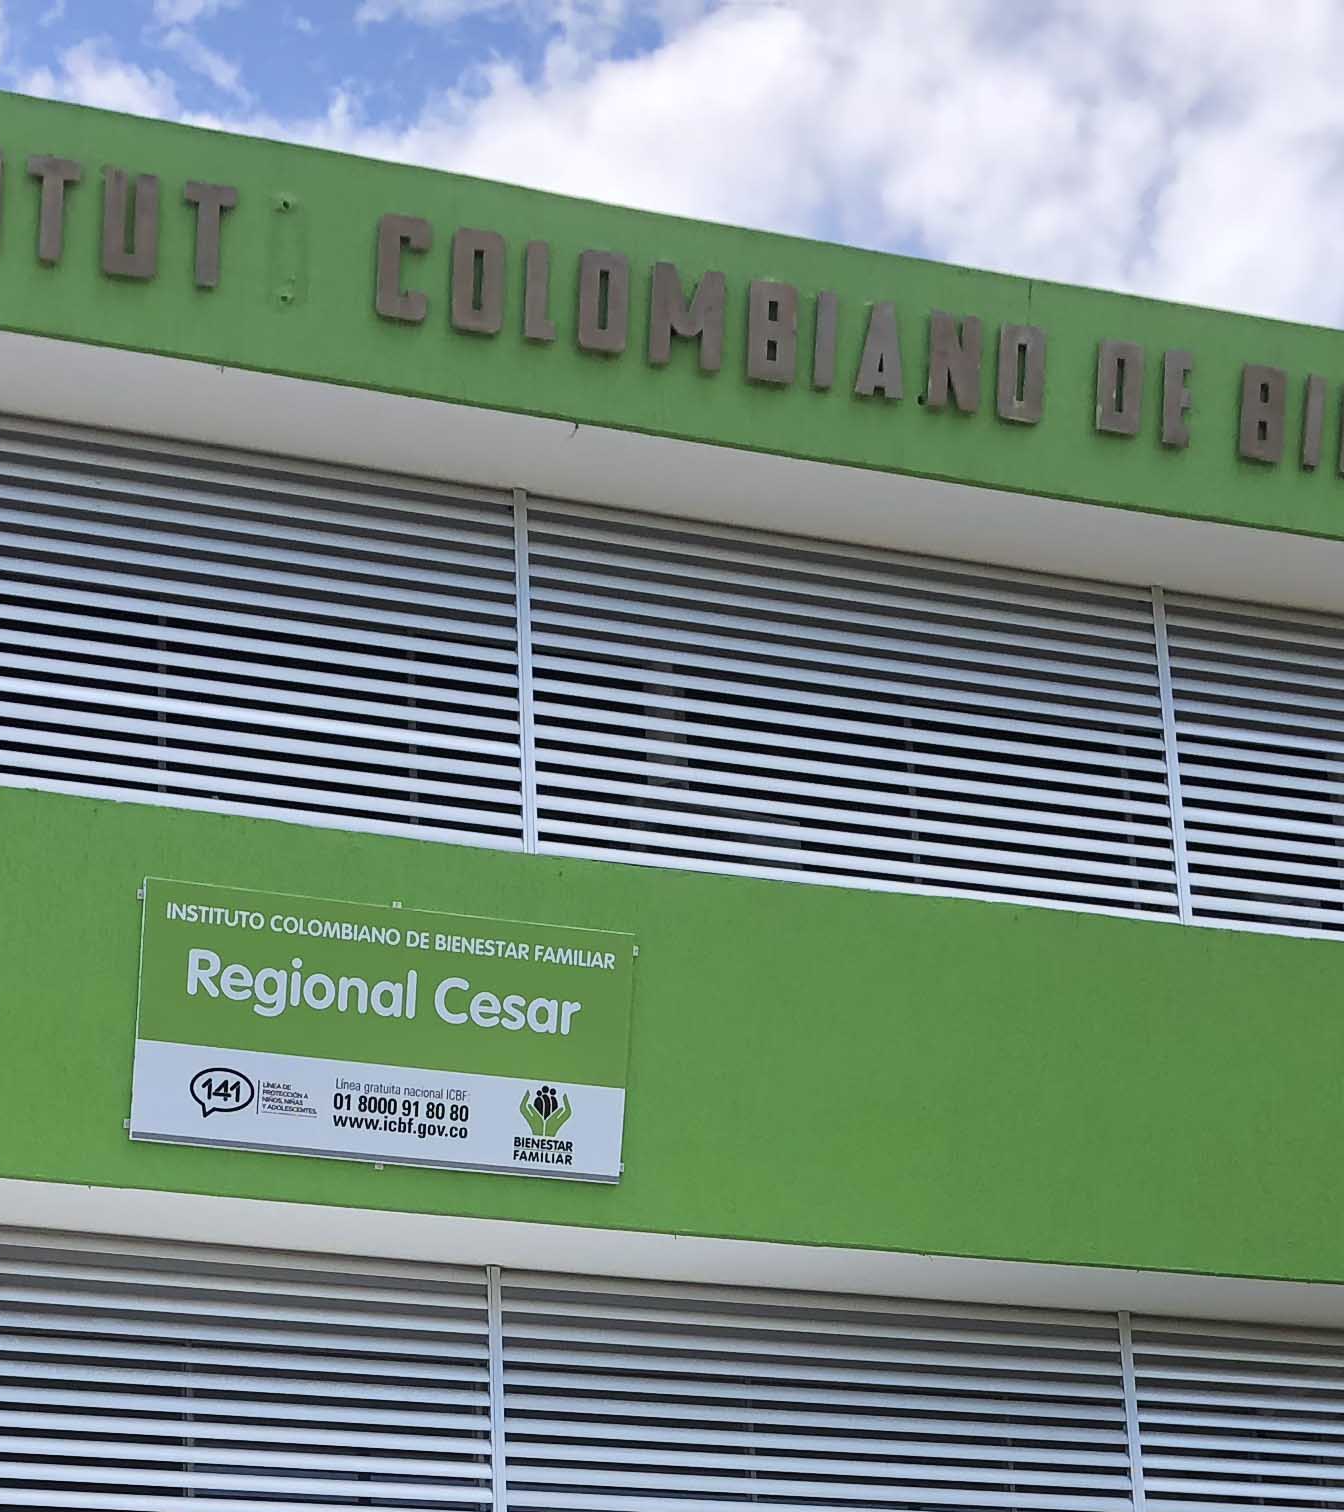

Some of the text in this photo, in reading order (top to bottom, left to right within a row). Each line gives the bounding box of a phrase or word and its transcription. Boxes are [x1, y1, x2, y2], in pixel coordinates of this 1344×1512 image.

[375, 212, 1049, 424] COLOMBIANO
[1096, 338, 1194, 449] DE
[166, 902, 616, 969] INSTITUTO COLOMBIANO DE BIENESTAR FAMILIAR
[187, 949, 581, 1035] Regional Cesar
[201, 1078, 241, 1102] 141
[335, 1077, 362, 1092] Línea
[364, 1082, 401, 1096] gratuita
[403, 1086, 444, 1100] nacional
[333, 1093, 469, 1122] 01 8000 91 80 80
[333, 1114, 468, 1139] www.icbf.gov.co
[513, 1136, 573, 1153] BIENESTAR
[513, 1150, 573, 1165] FAMILIAR
